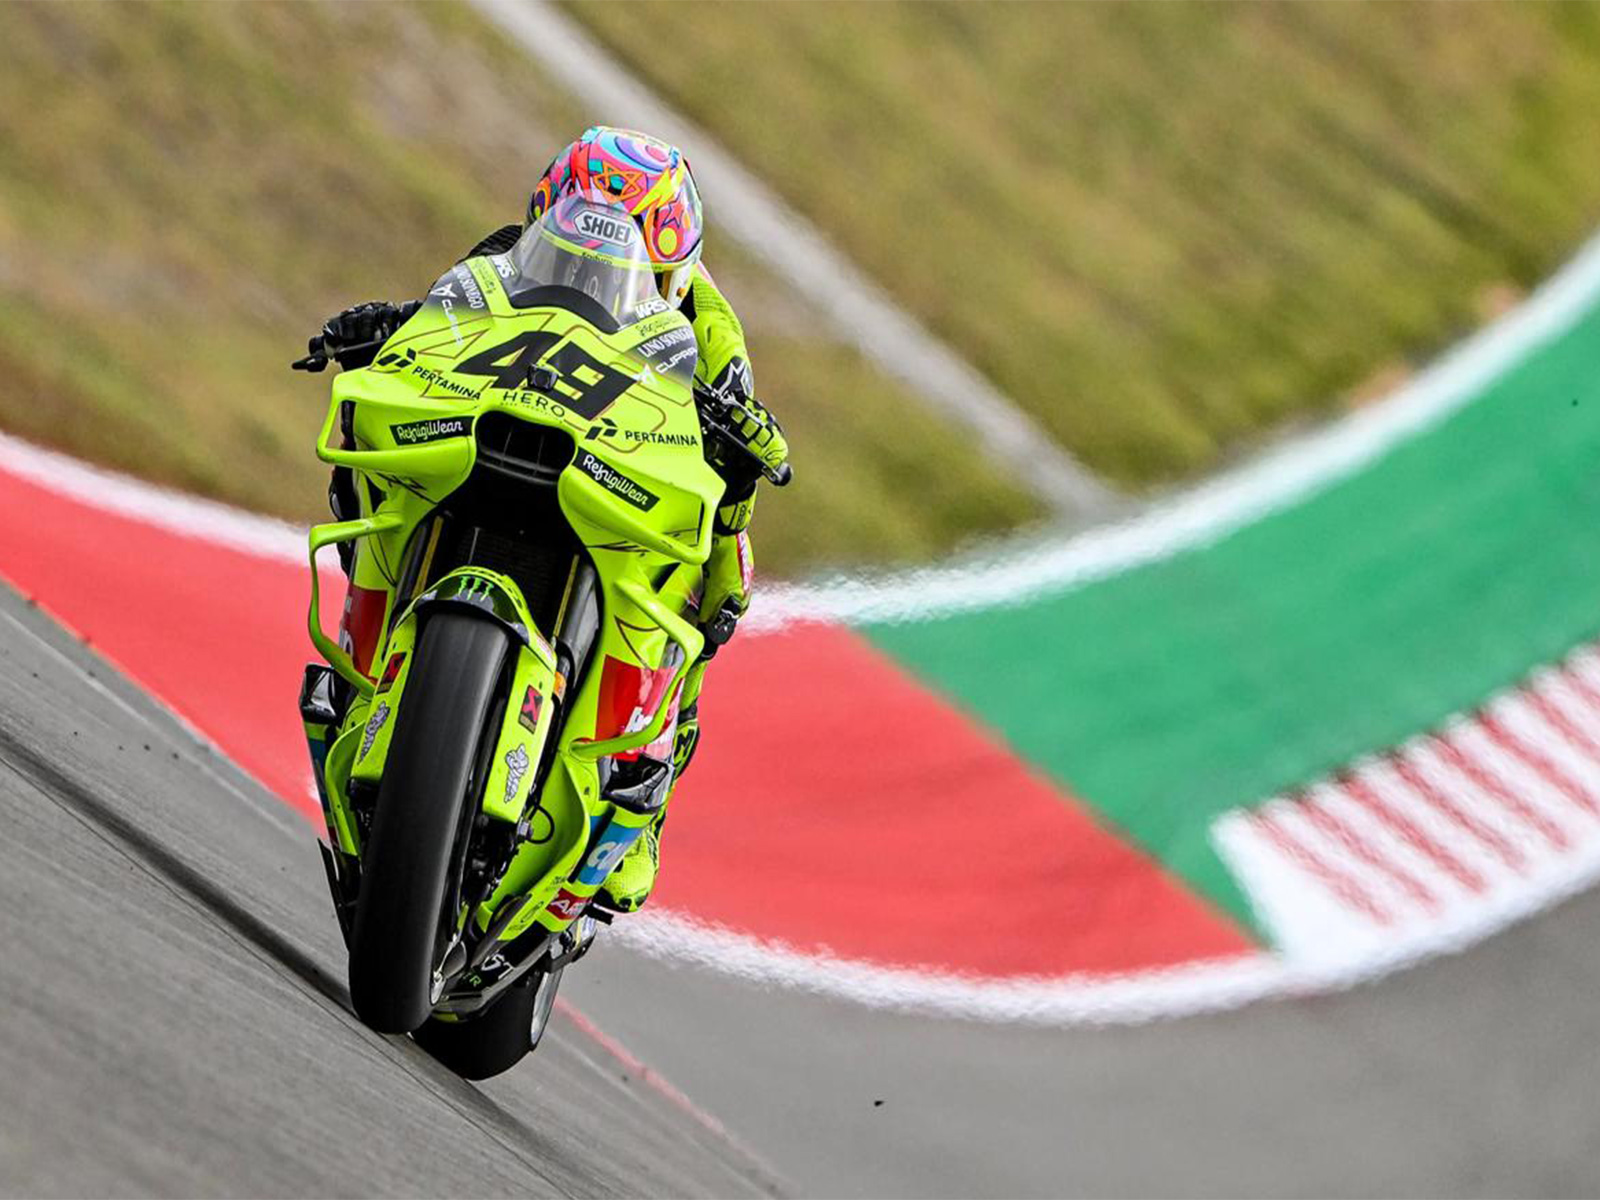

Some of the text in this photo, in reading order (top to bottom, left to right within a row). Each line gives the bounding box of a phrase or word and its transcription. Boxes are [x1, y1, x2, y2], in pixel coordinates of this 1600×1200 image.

[581, 213, 631, 244] SHOEI
[655, 347, 697, 374] CUPRA
[412, 365, 481, 400] PERTAMINA
[452, 331, 637, 422] 49
[503, 391, 565, 418] HERO
[396, 420, 463, 443] RefrigiWear
[624, 430, 699, 447] PERTAMINA
[583, 454, 649, 505] RefrigiWear
